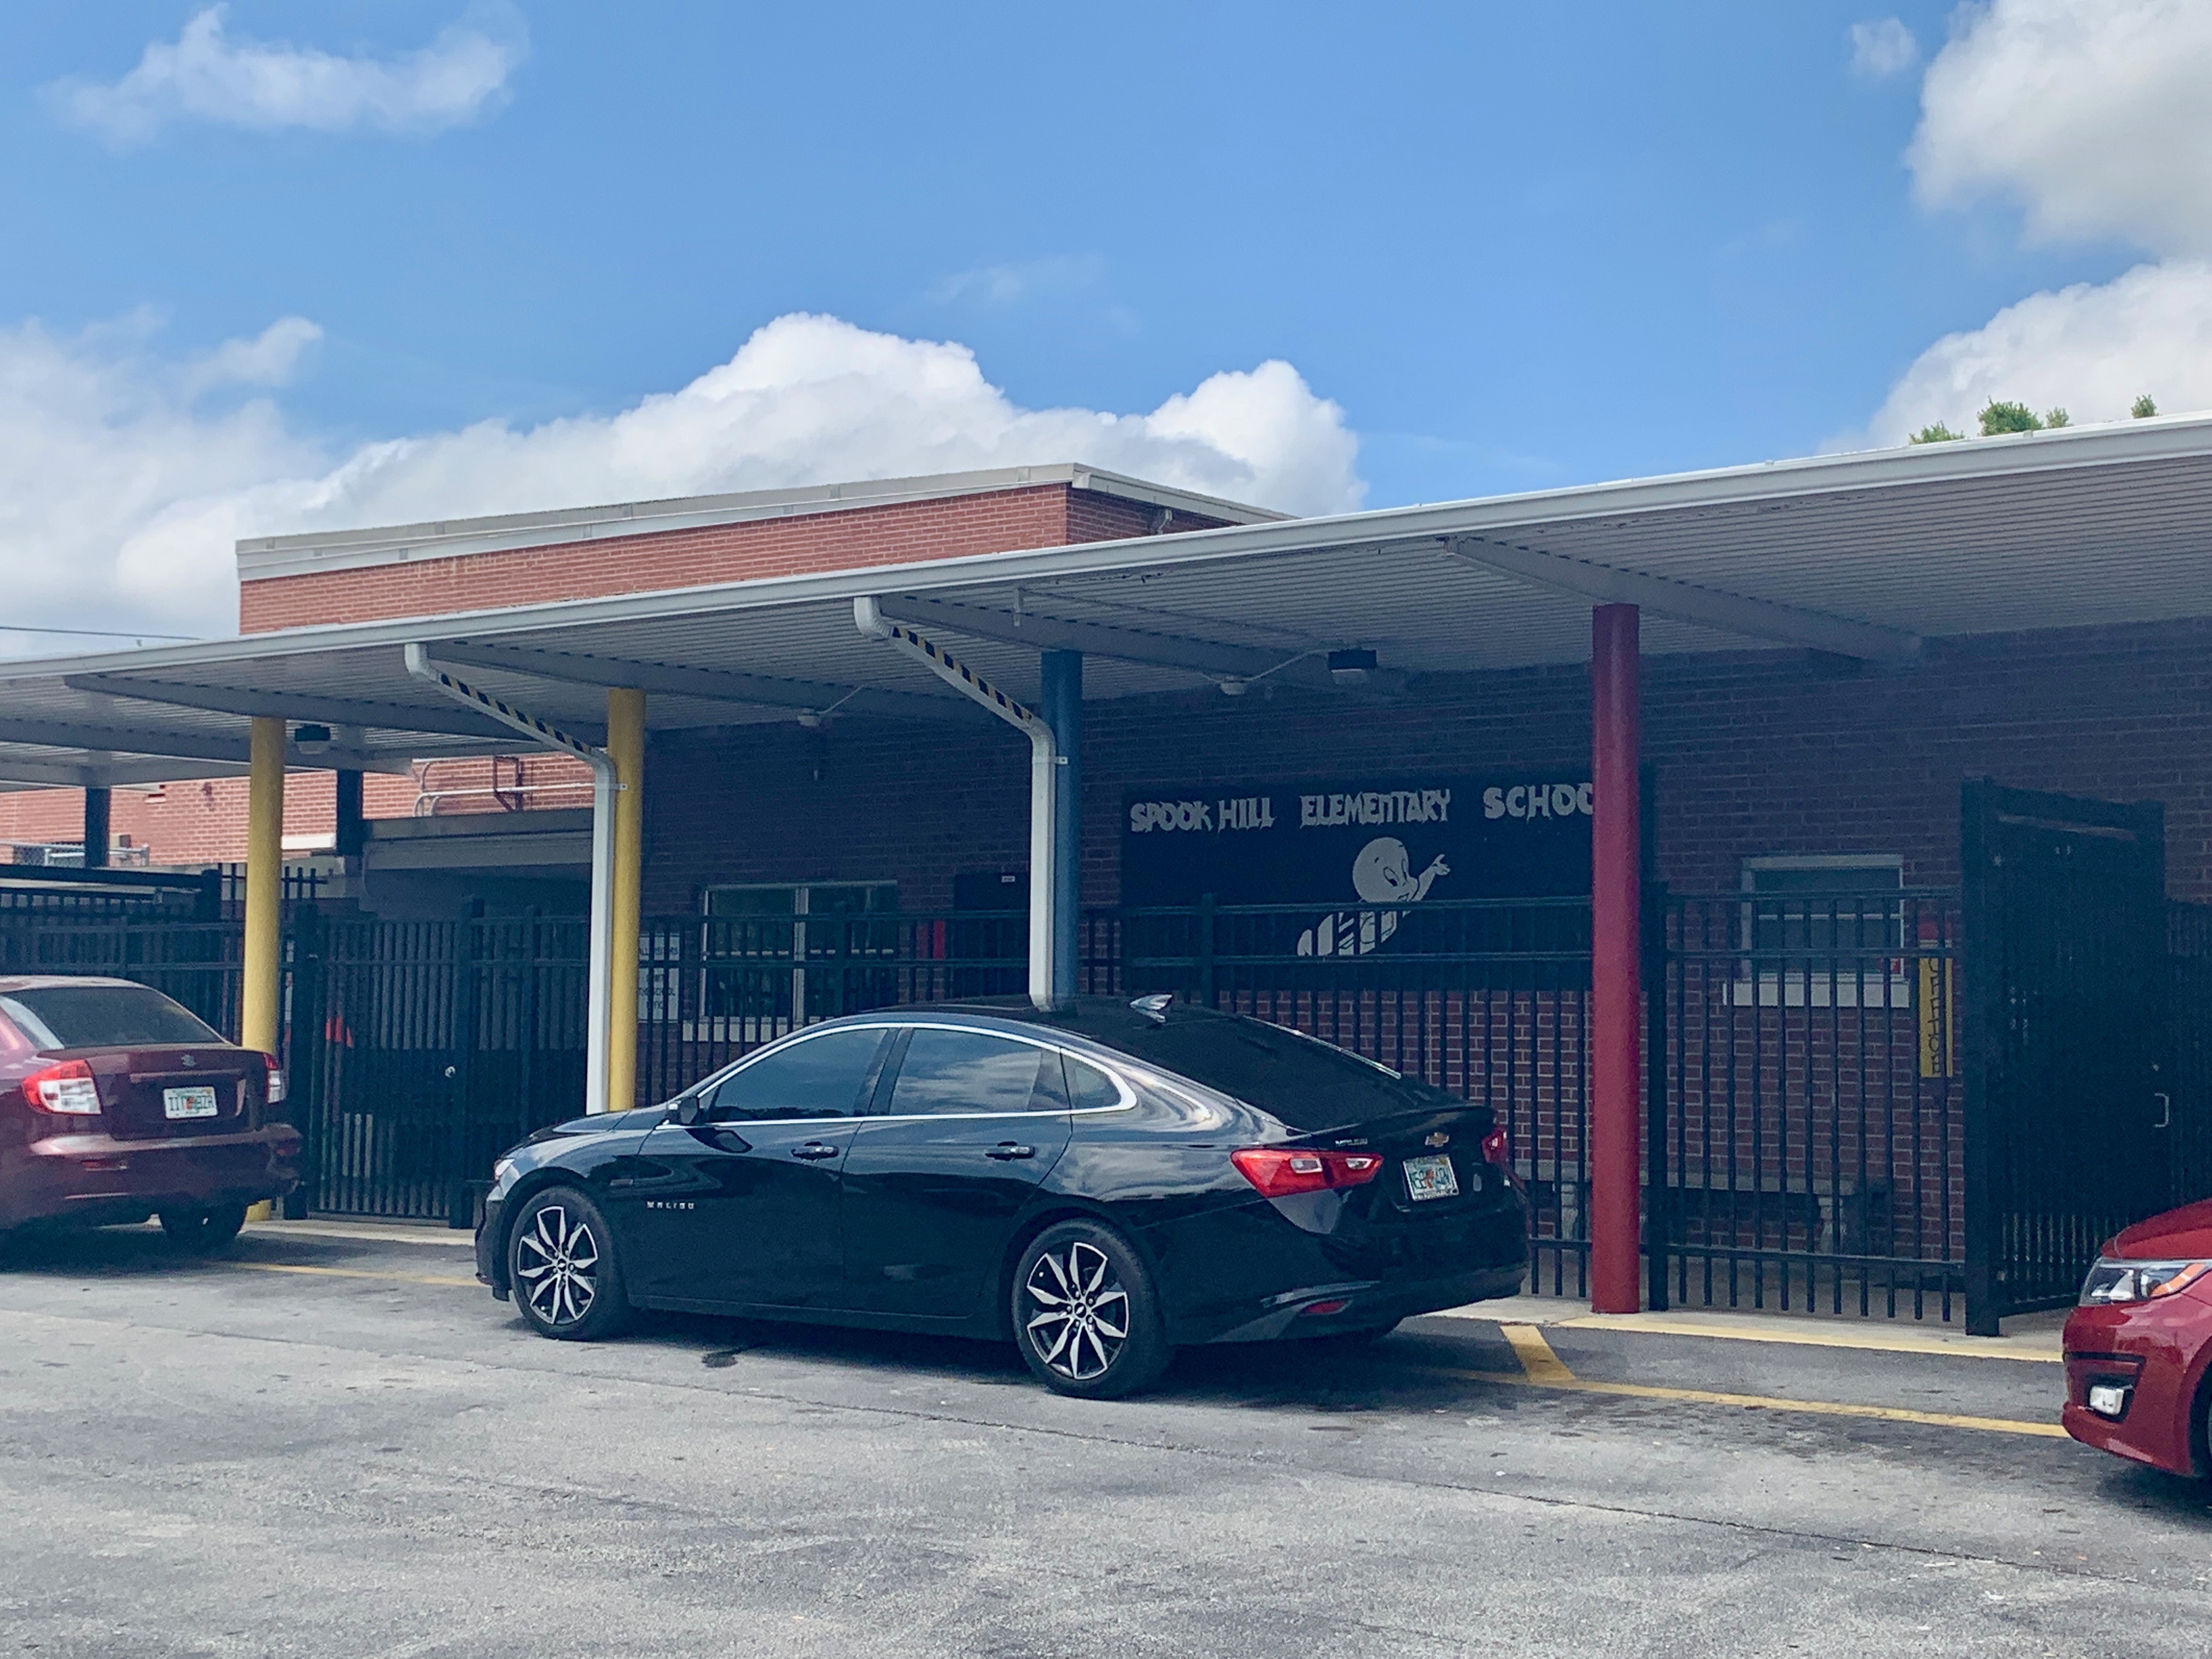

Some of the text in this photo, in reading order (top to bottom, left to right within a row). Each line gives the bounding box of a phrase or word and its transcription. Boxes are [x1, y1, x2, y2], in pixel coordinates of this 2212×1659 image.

[1130, 782, 1594, 833] SPOOK HILL ELEMENTARY SCHOO
